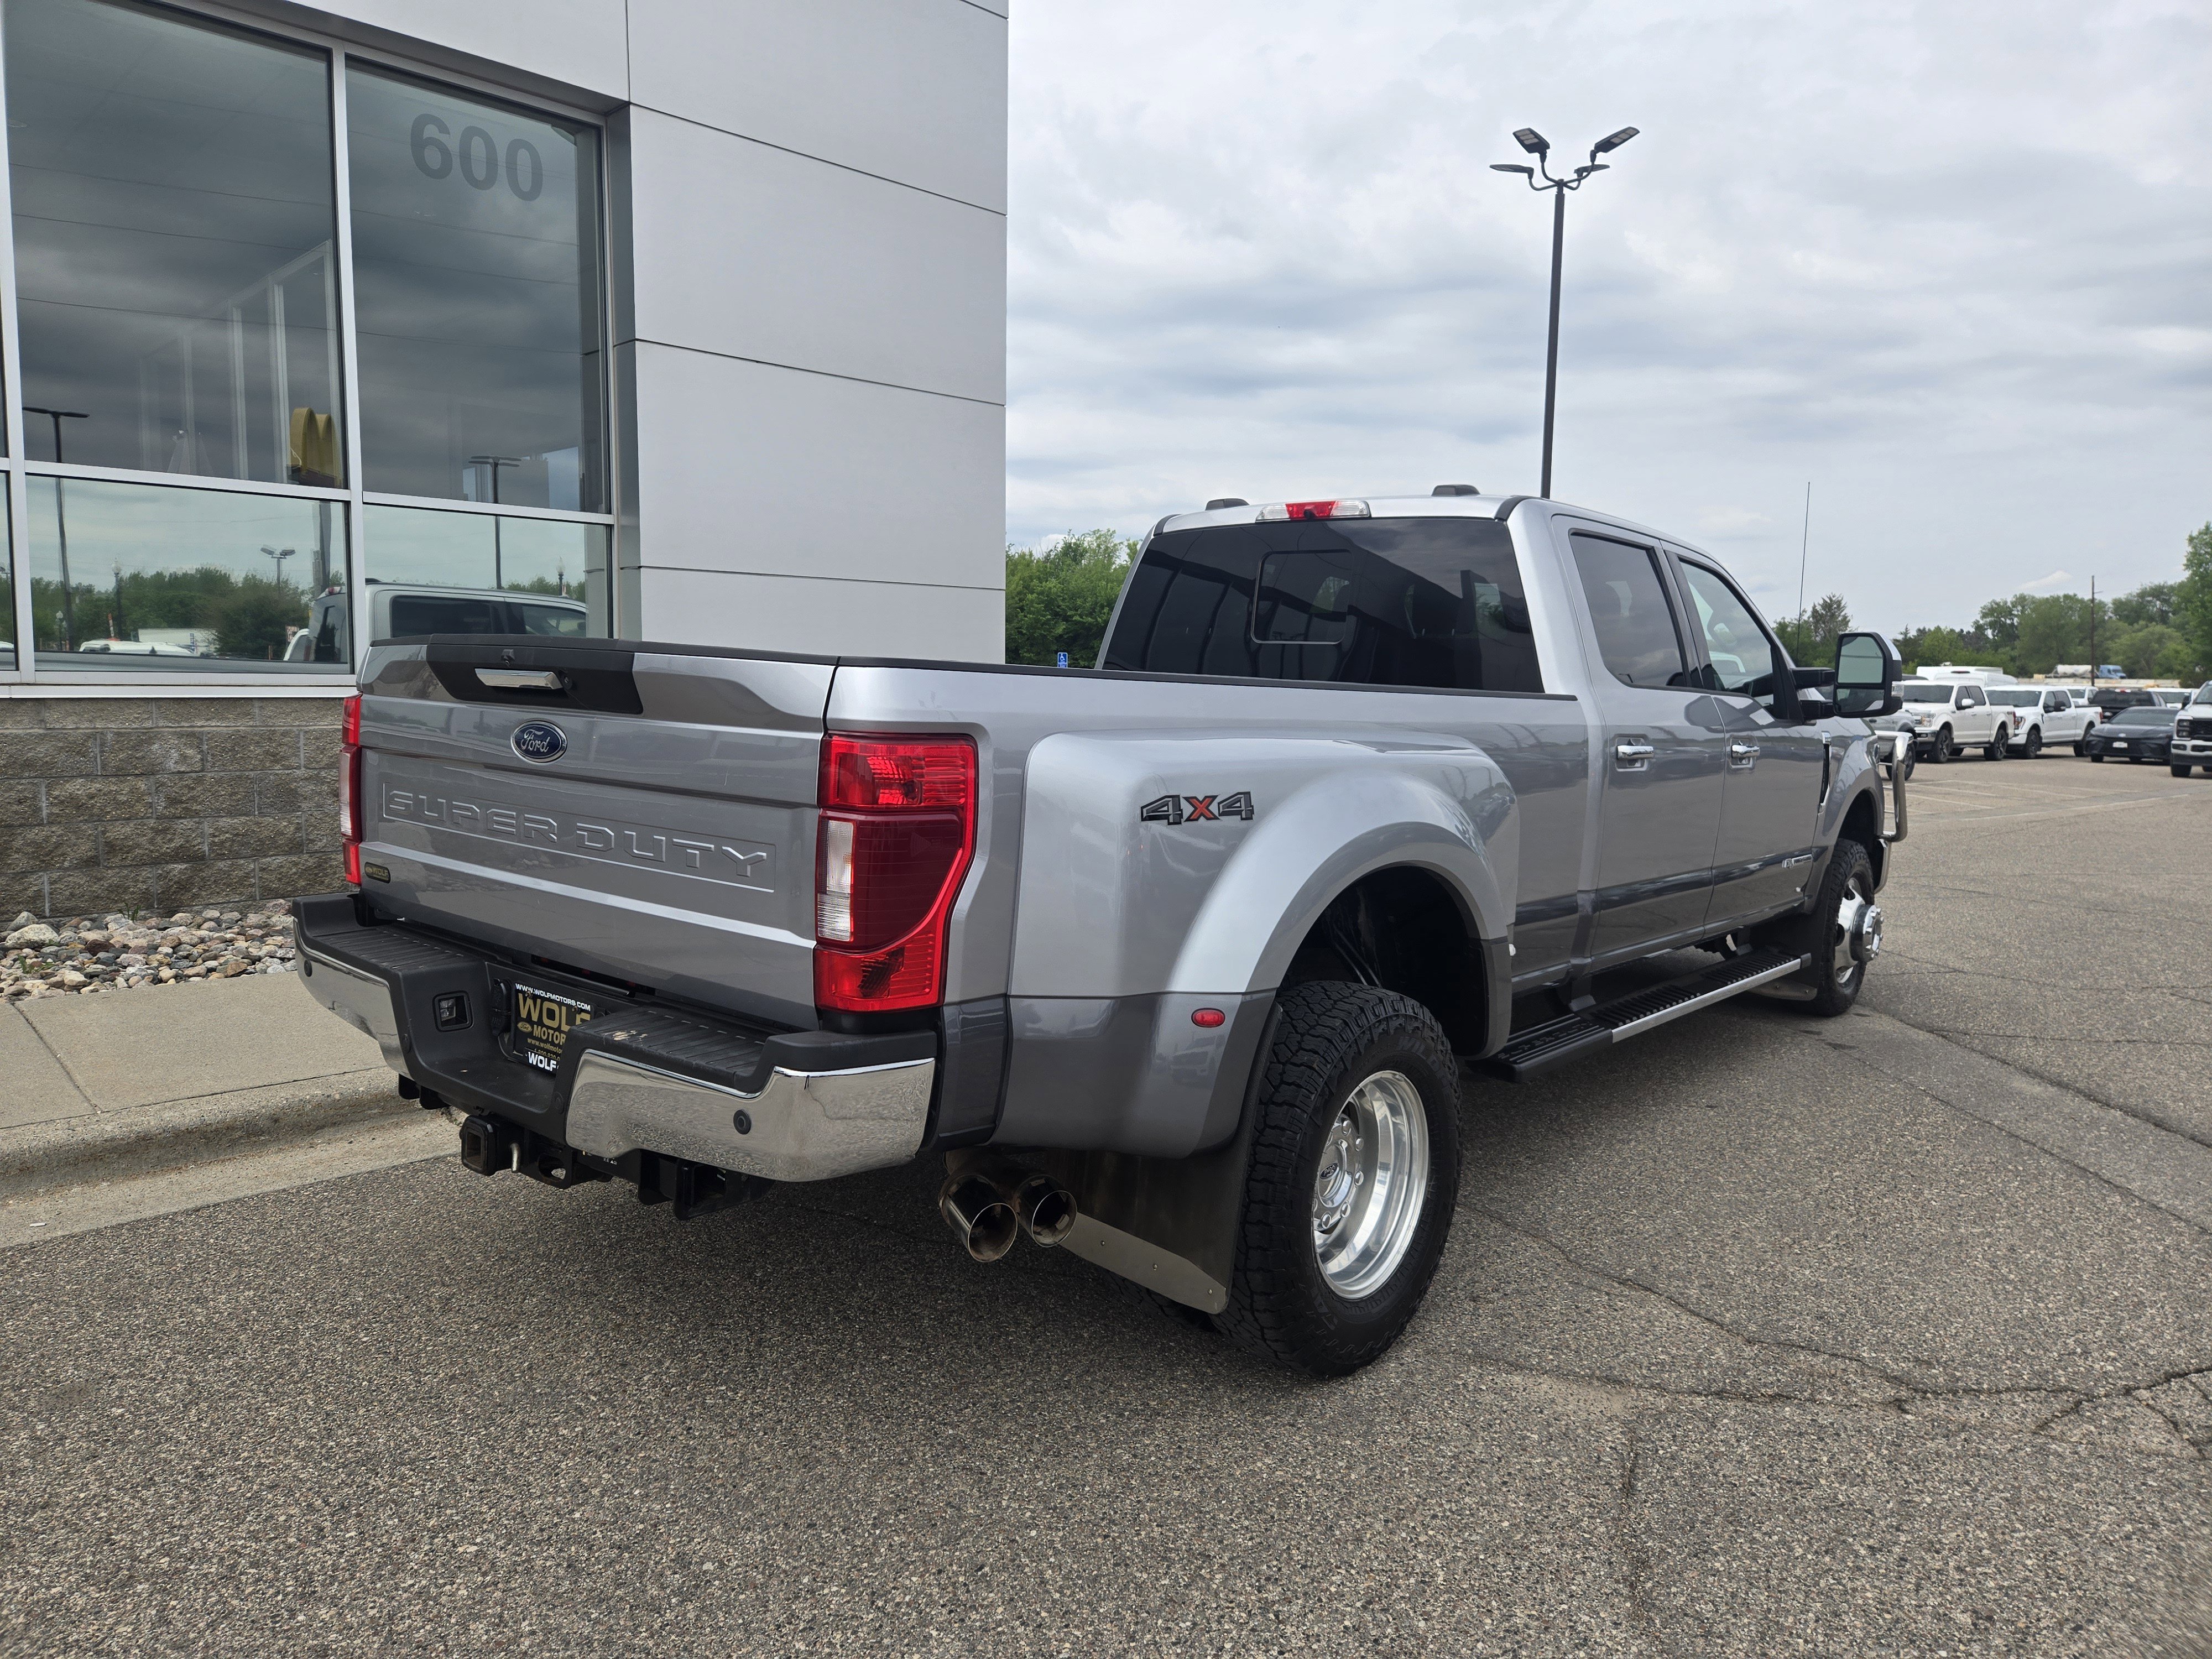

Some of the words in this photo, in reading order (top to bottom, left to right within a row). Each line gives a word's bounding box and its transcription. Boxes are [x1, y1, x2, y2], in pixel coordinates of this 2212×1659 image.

[411, 113, 543, 201] 600
[389, 790, 557, 843] SUPER
[576, 822, 767, 878] DUTY
[515, 983, 591, 1011] WWW.WOLFMOTORSCOM
[528, 1051, 557, 1071] WOLF
